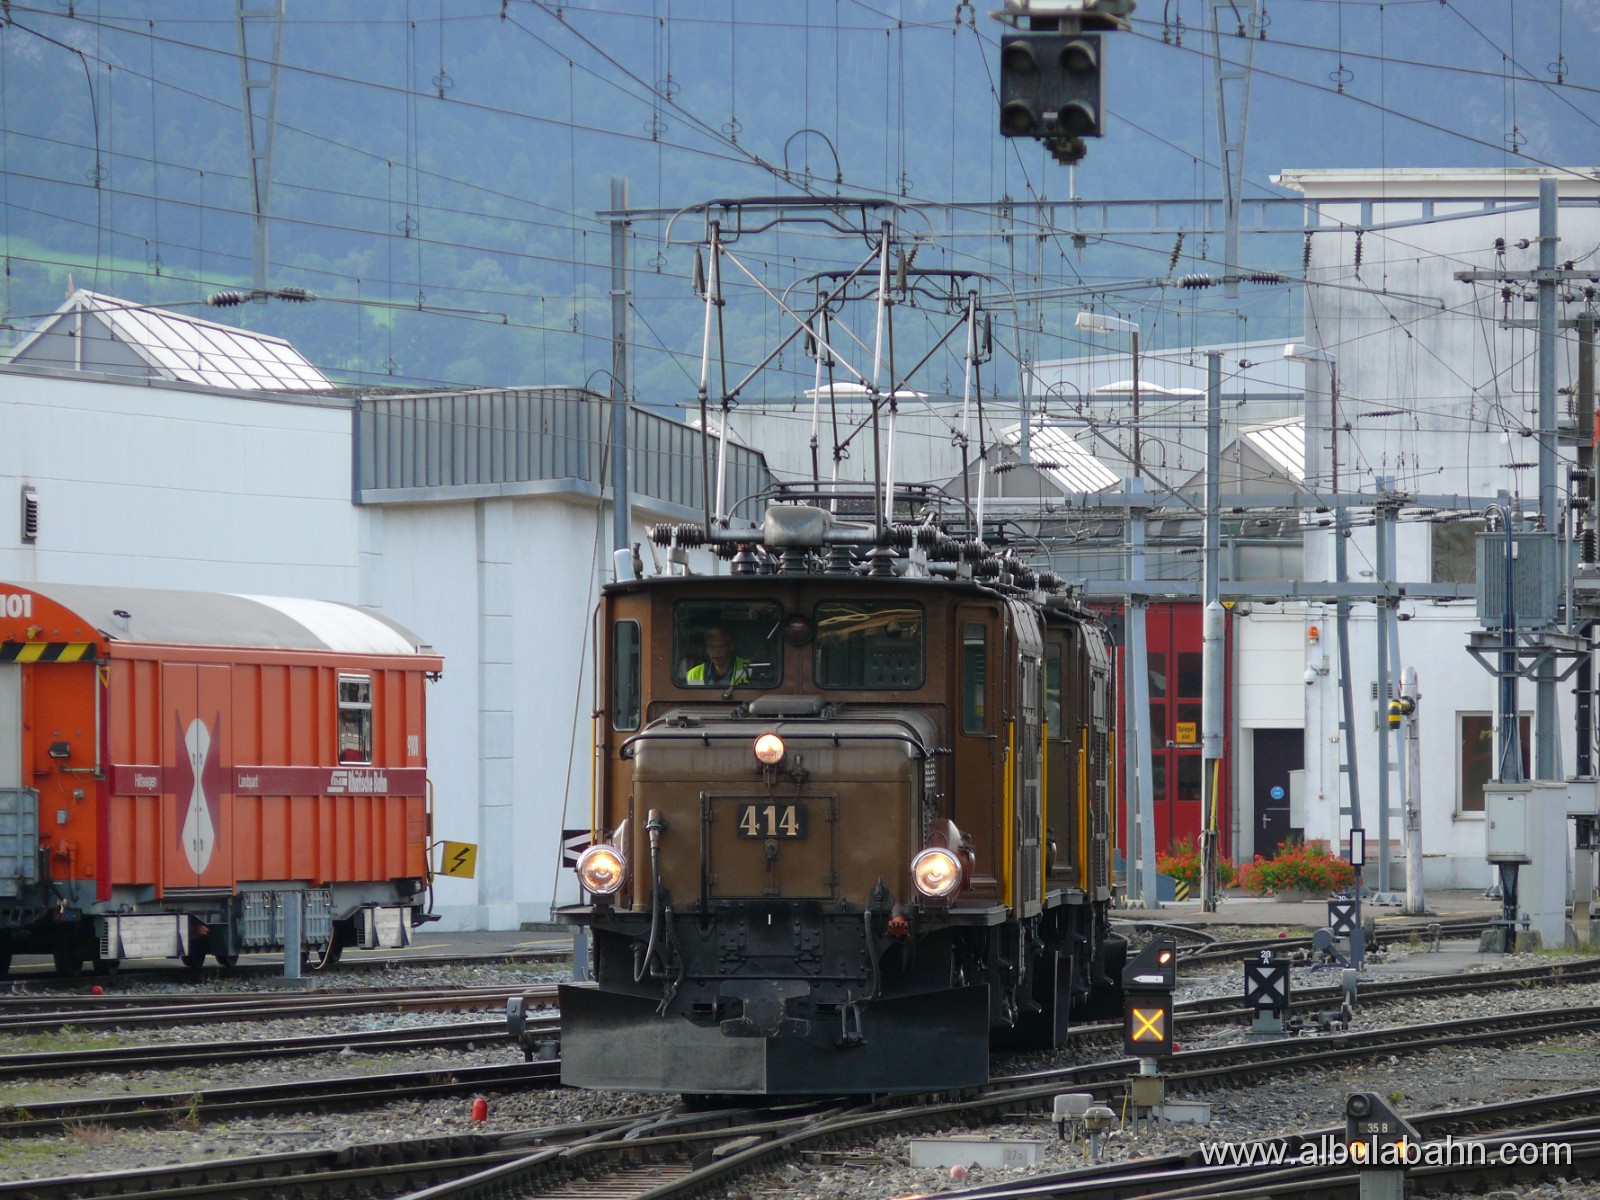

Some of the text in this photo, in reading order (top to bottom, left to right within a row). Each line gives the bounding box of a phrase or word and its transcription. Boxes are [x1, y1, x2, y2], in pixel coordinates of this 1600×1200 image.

[739, 805, 799, 836] 414
[1262, 957, 1270, 965] A
[1367, 1122, 1388, 1133] 35 B
